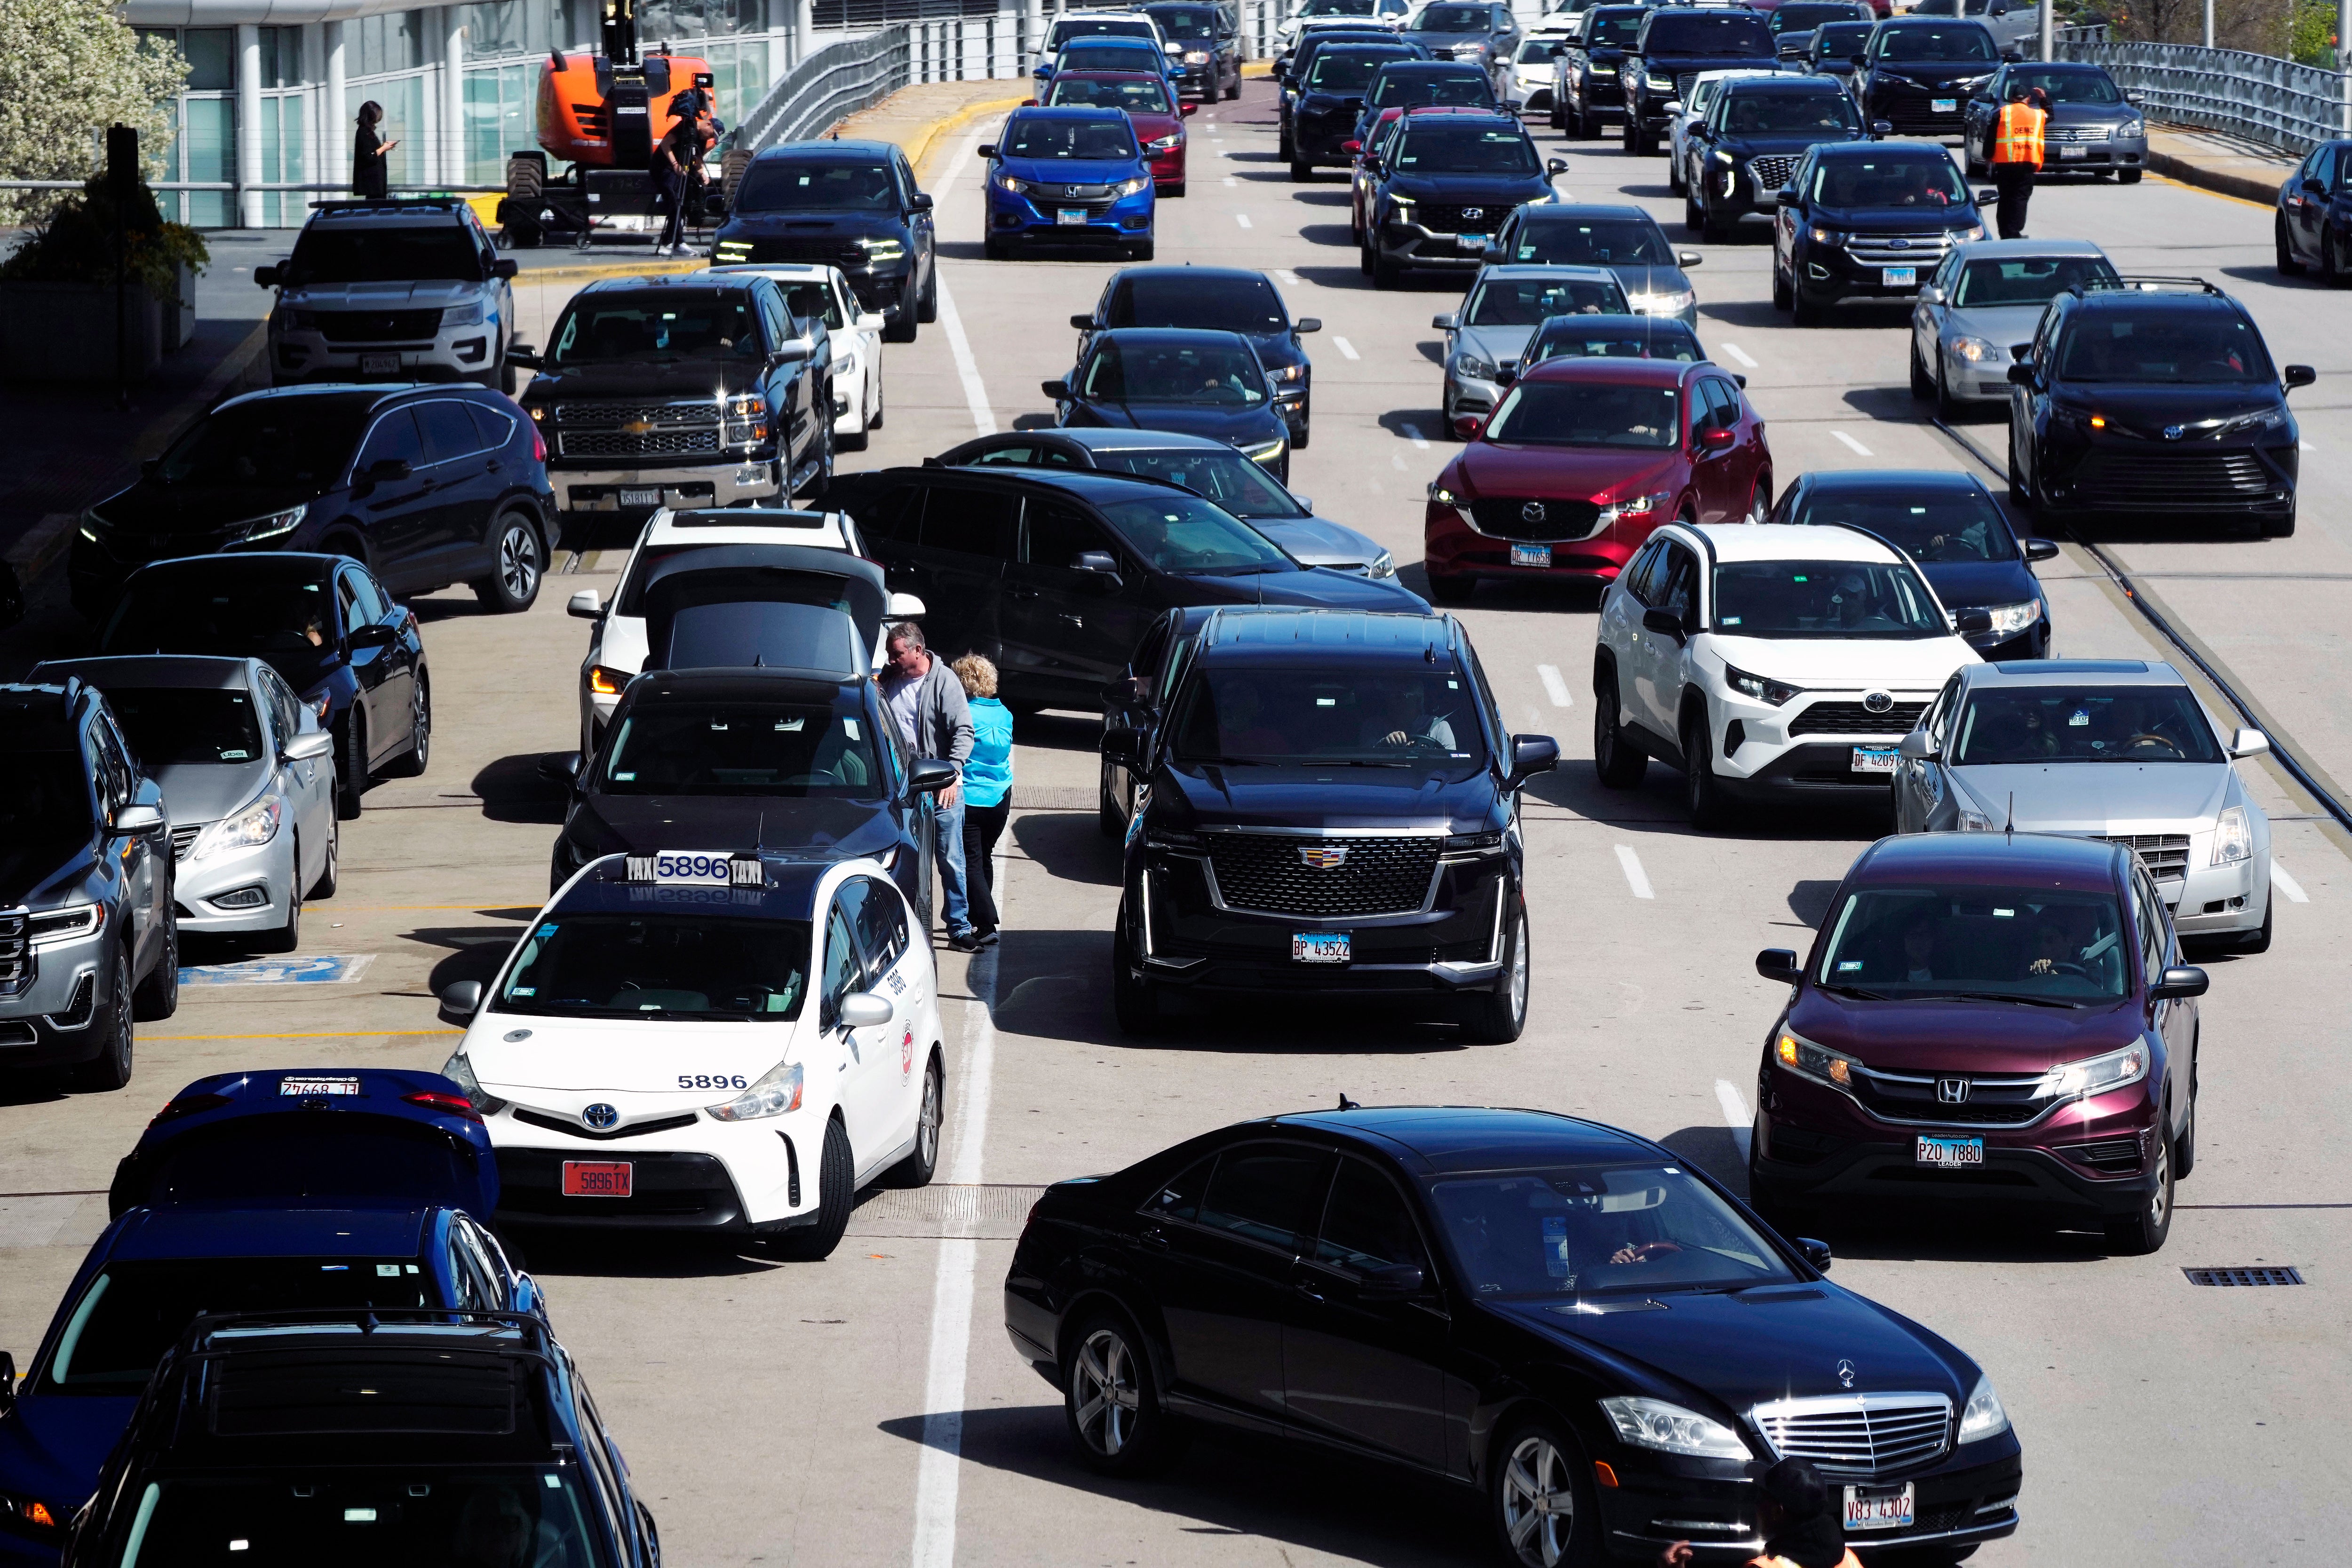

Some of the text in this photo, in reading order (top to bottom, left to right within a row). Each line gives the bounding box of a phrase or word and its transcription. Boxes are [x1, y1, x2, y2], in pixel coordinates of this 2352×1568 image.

[1512, 550, 1550, 562] DR 77658
[1855, 753, 1900, 767] DF 42097
[626, 856, 763, 884] TAXI 5896 TAXI
[1294, 941, 1350, 956] BP 43522
[887, 969, 906, 996] 5896
[903, 1041, 912, 1065] SUN
[283, 1084, 357, 1095] EL 89942
[678, 1075, 747, 1089] 5896
[1919, 1143, 1981, 1162] P20 7880
[581, 1172, 629, 1190] 5896TX
[1848, 1497, 1910, 1521] V83 4302
